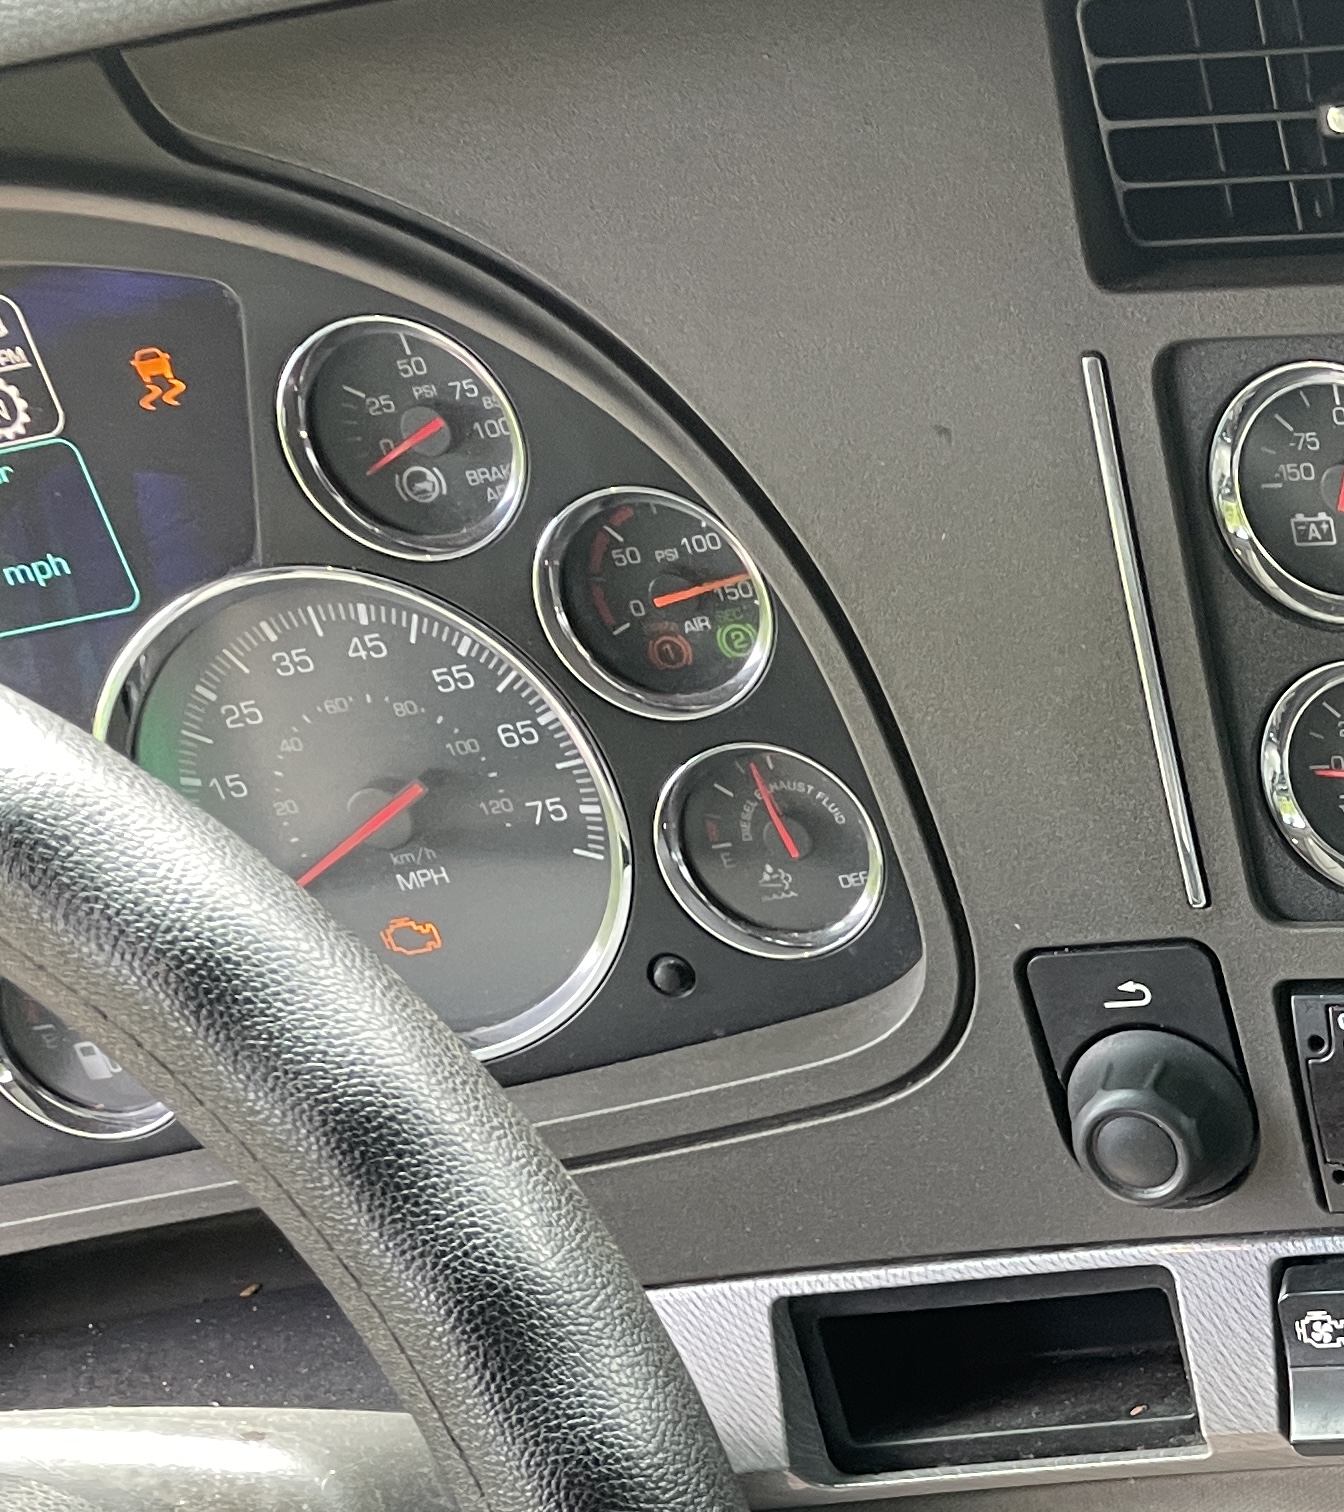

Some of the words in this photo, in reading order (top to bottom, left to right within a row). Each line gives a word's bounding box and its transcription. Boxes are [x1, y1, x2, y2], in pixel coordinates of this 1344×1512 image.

[396, 356, 427, 378] 50
[412, 384, 438, 400] PSI
[448, 379, 478, 400] 75
[366, 395, 395, 415] 25
[681, 532, 722, 554] 100
[612, 547, 641, 566] 50
[655, 548, 679, 563] PSI
[2, 553, 71, 587] mph
[629, 600, 645, 617] 0
[684, 615, 712, 634] AIR
[346, 634, 388, 661] 45
[271, 648, 314, 677] 35
[431, 665, 475, 693] 55
[220, 702, 263, 729] 25
[324, 698, 349, 716] 60
[393, 700, 419, 716] 80
[280, 737, 303, 753] 40
[496, 721, 540, 749] 65
[445, 739, 480, 756] 100
[209, 773, 248, 801] 15
[274, 801, 298, 816] 20
[479, 798, 514, 815] 120
[524, 798, 568, 825] 75
[754, 780, 815, 800] EHAUST
[815, 791, 847, 825] FLUID
[390, 846, 437, 865] km/h
[396, 867, 450, 891] MPH
[838, 871, 868, 888] DEF
